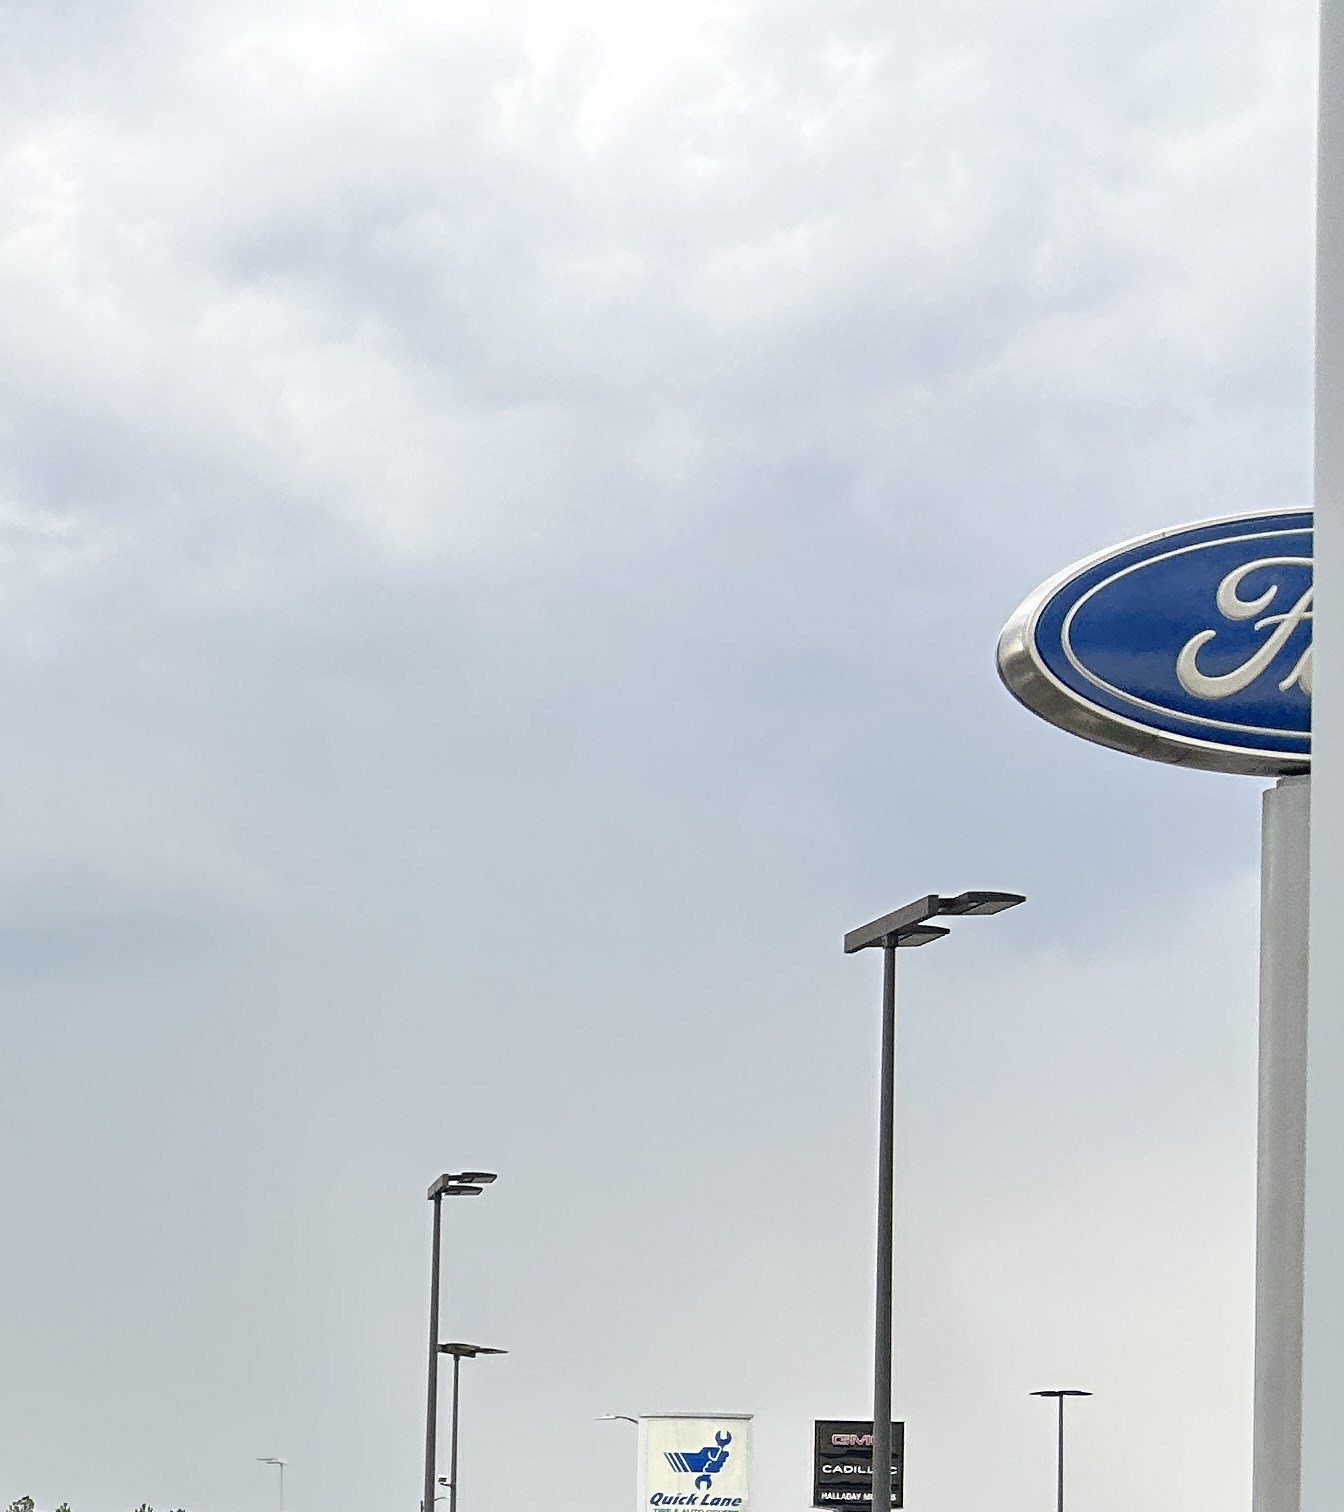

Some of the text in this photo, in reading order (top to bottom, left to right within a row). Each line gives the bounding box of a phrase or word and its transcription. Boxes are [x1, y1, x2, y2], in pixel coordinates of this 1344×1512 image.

[831, 1434, 875, 1446] GM
[822, 1465, 898, 1475] CADILLC
[650, 1492, 743, 1507] Quick Lane
